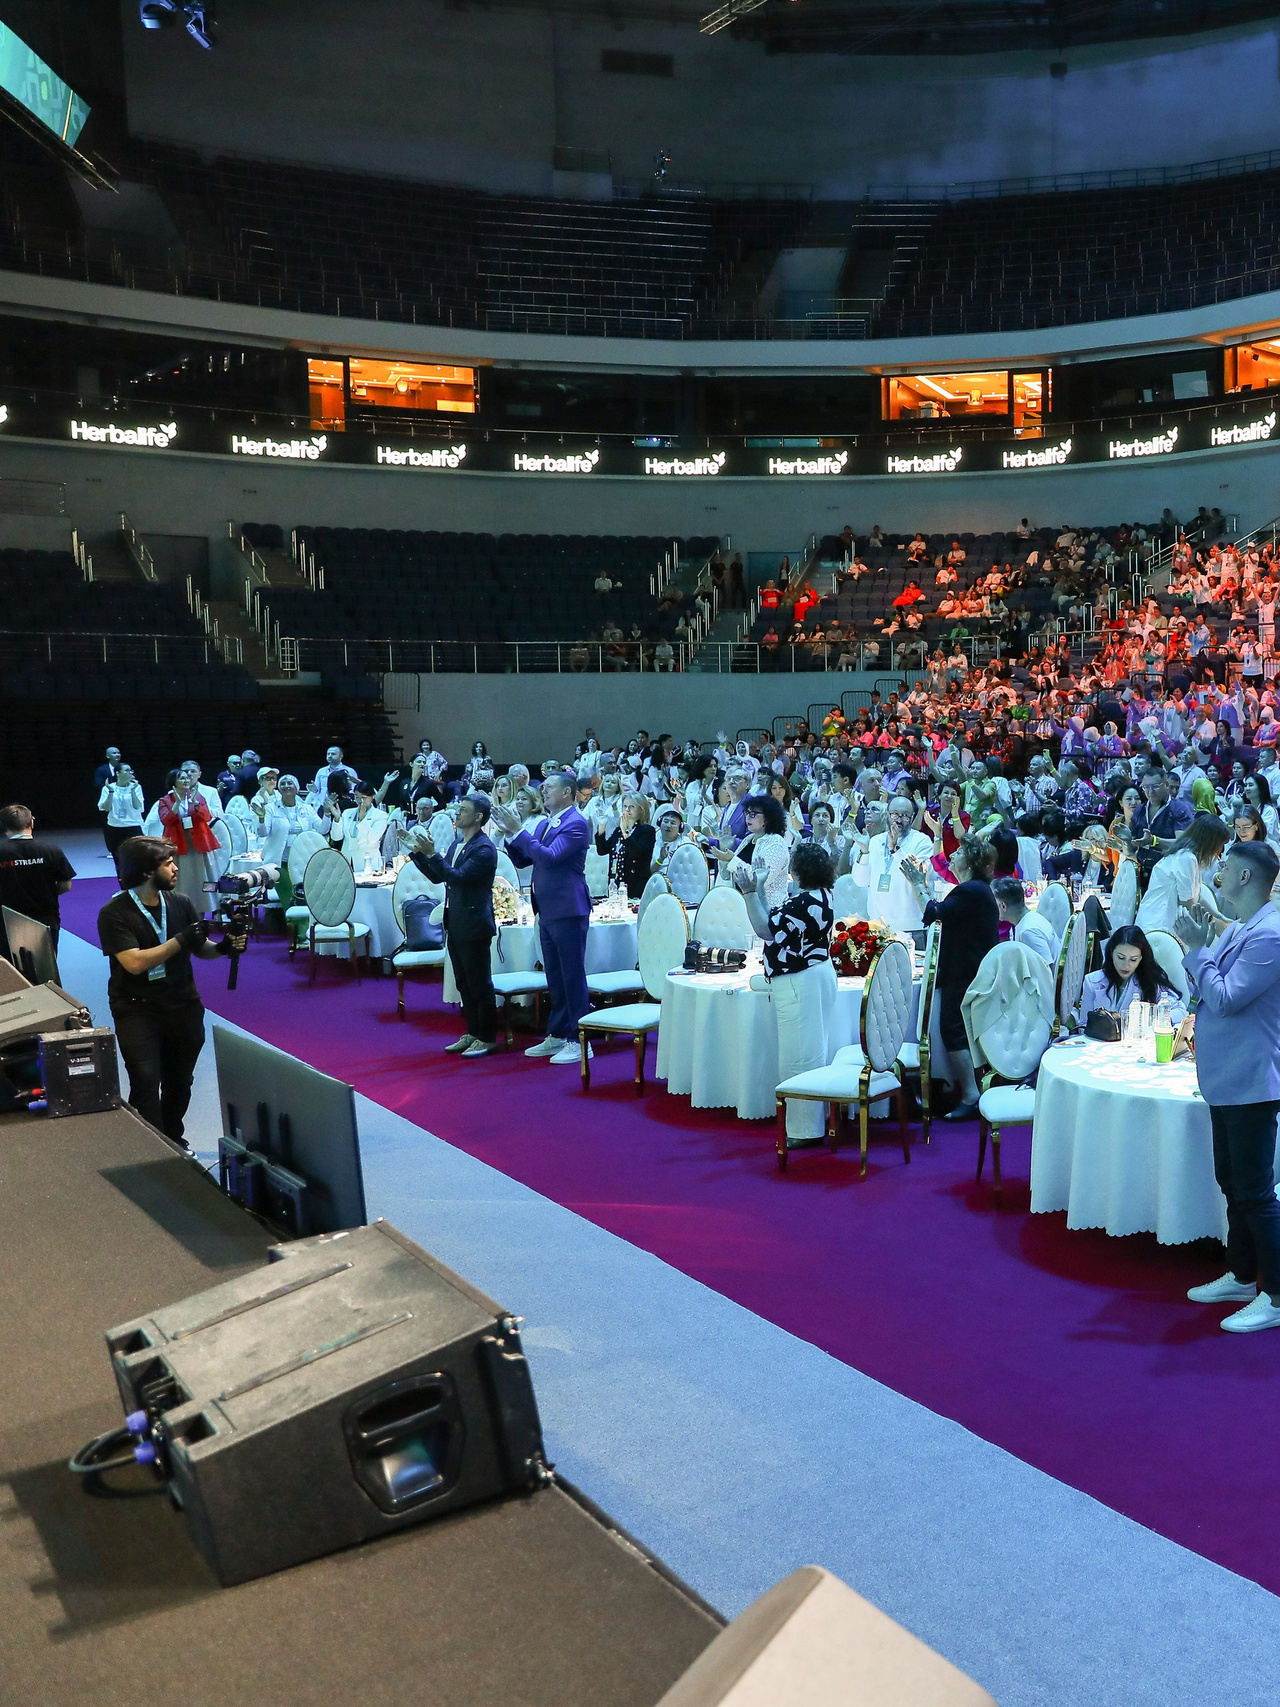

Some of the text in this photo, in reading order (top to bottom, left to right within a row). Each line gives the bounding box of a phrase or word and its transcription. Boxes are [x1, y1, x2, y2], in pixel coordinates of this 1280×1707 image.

[71, 421, 169, 448] Herbalife
[1211, 421, 1270, 446] Herbalife
[232, 435, 320, 460] Herbalife
[378, 446, 459, 468] Herbalife
[1109, 435, 1173, 458] Herbalife
[515, 453, 593, 473] Herbalife
[645, 458, 719, 475] Herbalife
[769, 458, 842, 475] Herbalife
[888, 455, 957, 473] Herbalife
[1003, 447, 1067, 468] Herbalife
